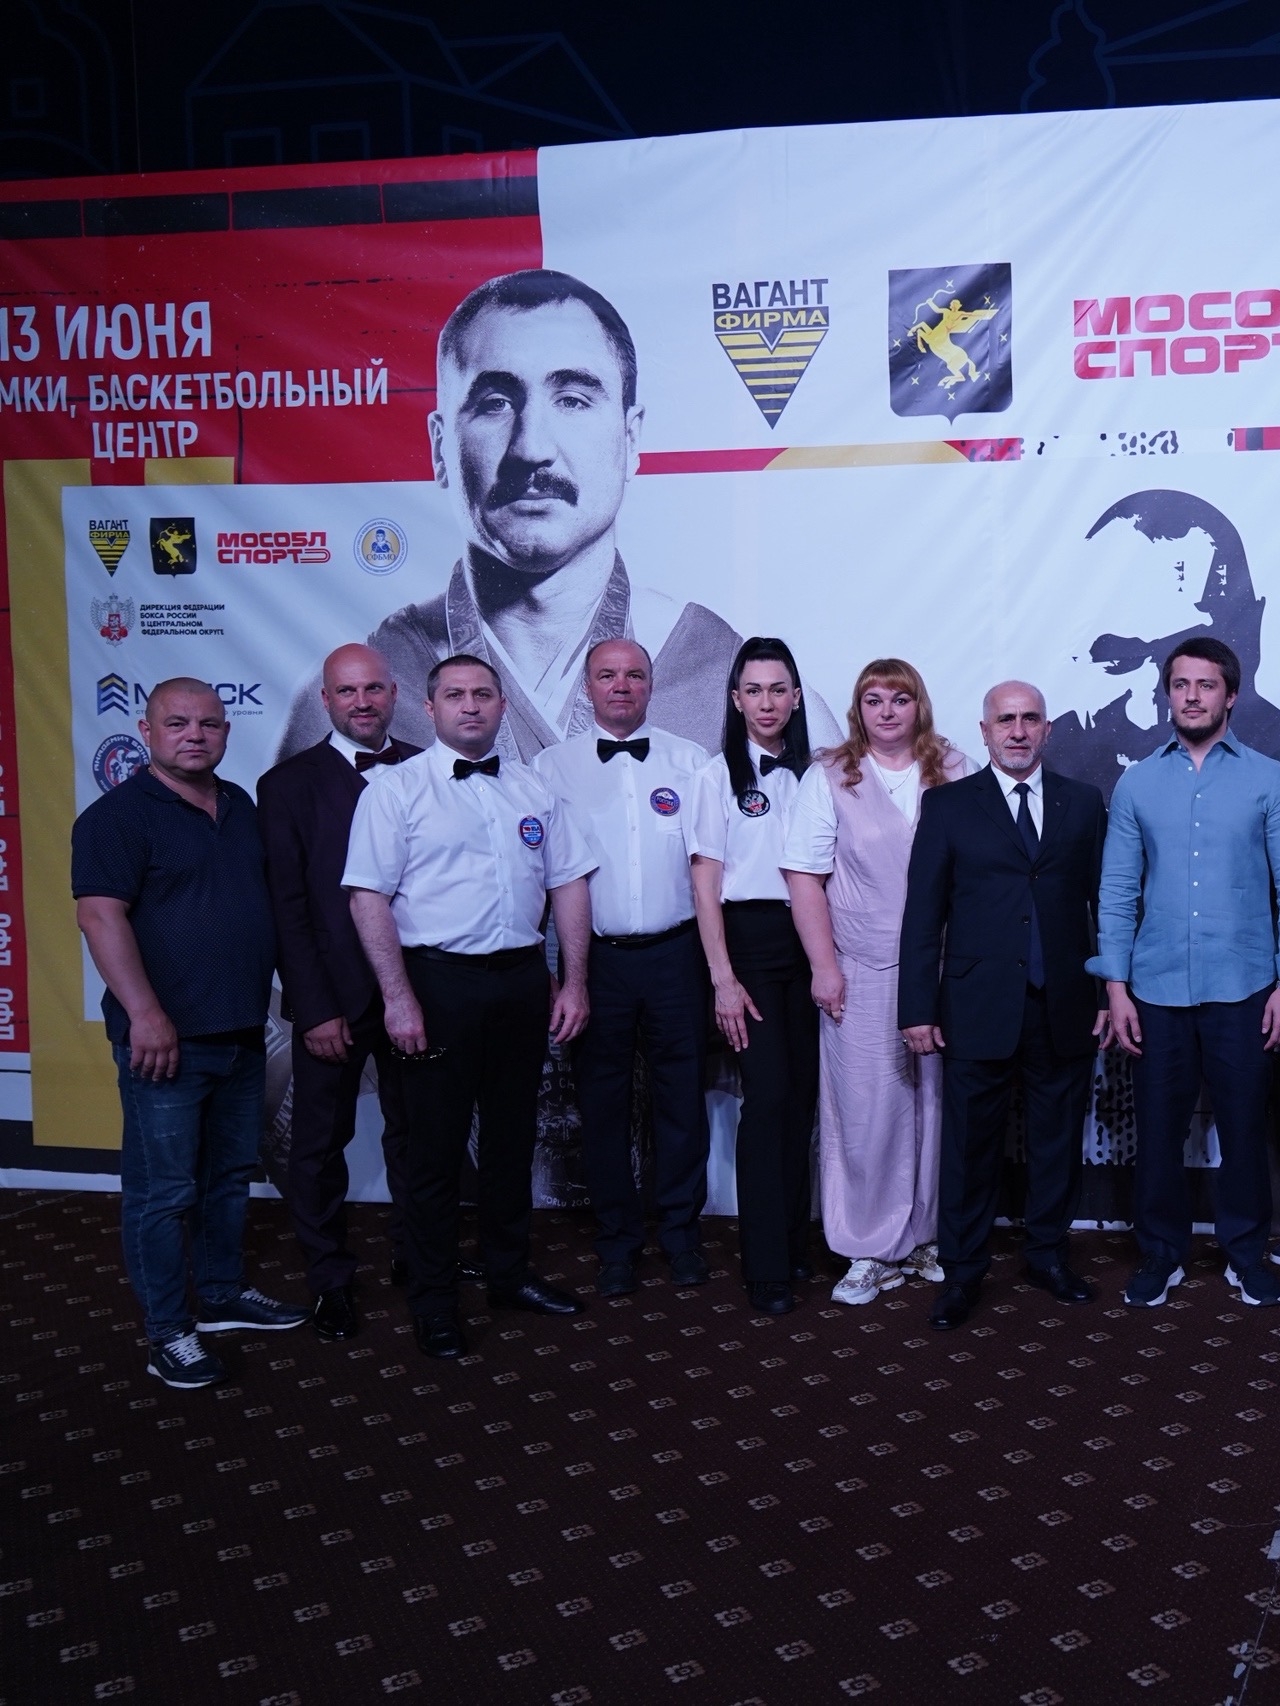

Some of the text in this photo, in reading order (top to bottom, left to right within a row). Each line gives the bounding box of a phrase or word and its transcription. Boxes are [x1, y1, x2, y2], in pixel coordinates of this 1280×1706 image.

[711, 278, 829, 310] ВАГАНТ
[714, 308, 828, 330] ФИРМА
[55, 301, 212, 361] ИЮНЯ
[89, 357, 388, 411] БАСКЕТБОЛЬНЫЙ
[92, 421, 199, 463] ЦЕНТР
[89, 519, 128, 530] ВАГАНТ
[217, 531, 326, 548] МОСОБЛ
[217, 548, 303, 564] СПОРТ
[140, 604, 225, 612] ДИРЕКЦИЯ ФЕДЕРАЦИИ
[141, 628, 225, 636] ФЕДЕРАЛЬНОМ ОКРУГЕ
[147, 620, 203, 628] ЦЕНТРАЛЬНОМ
